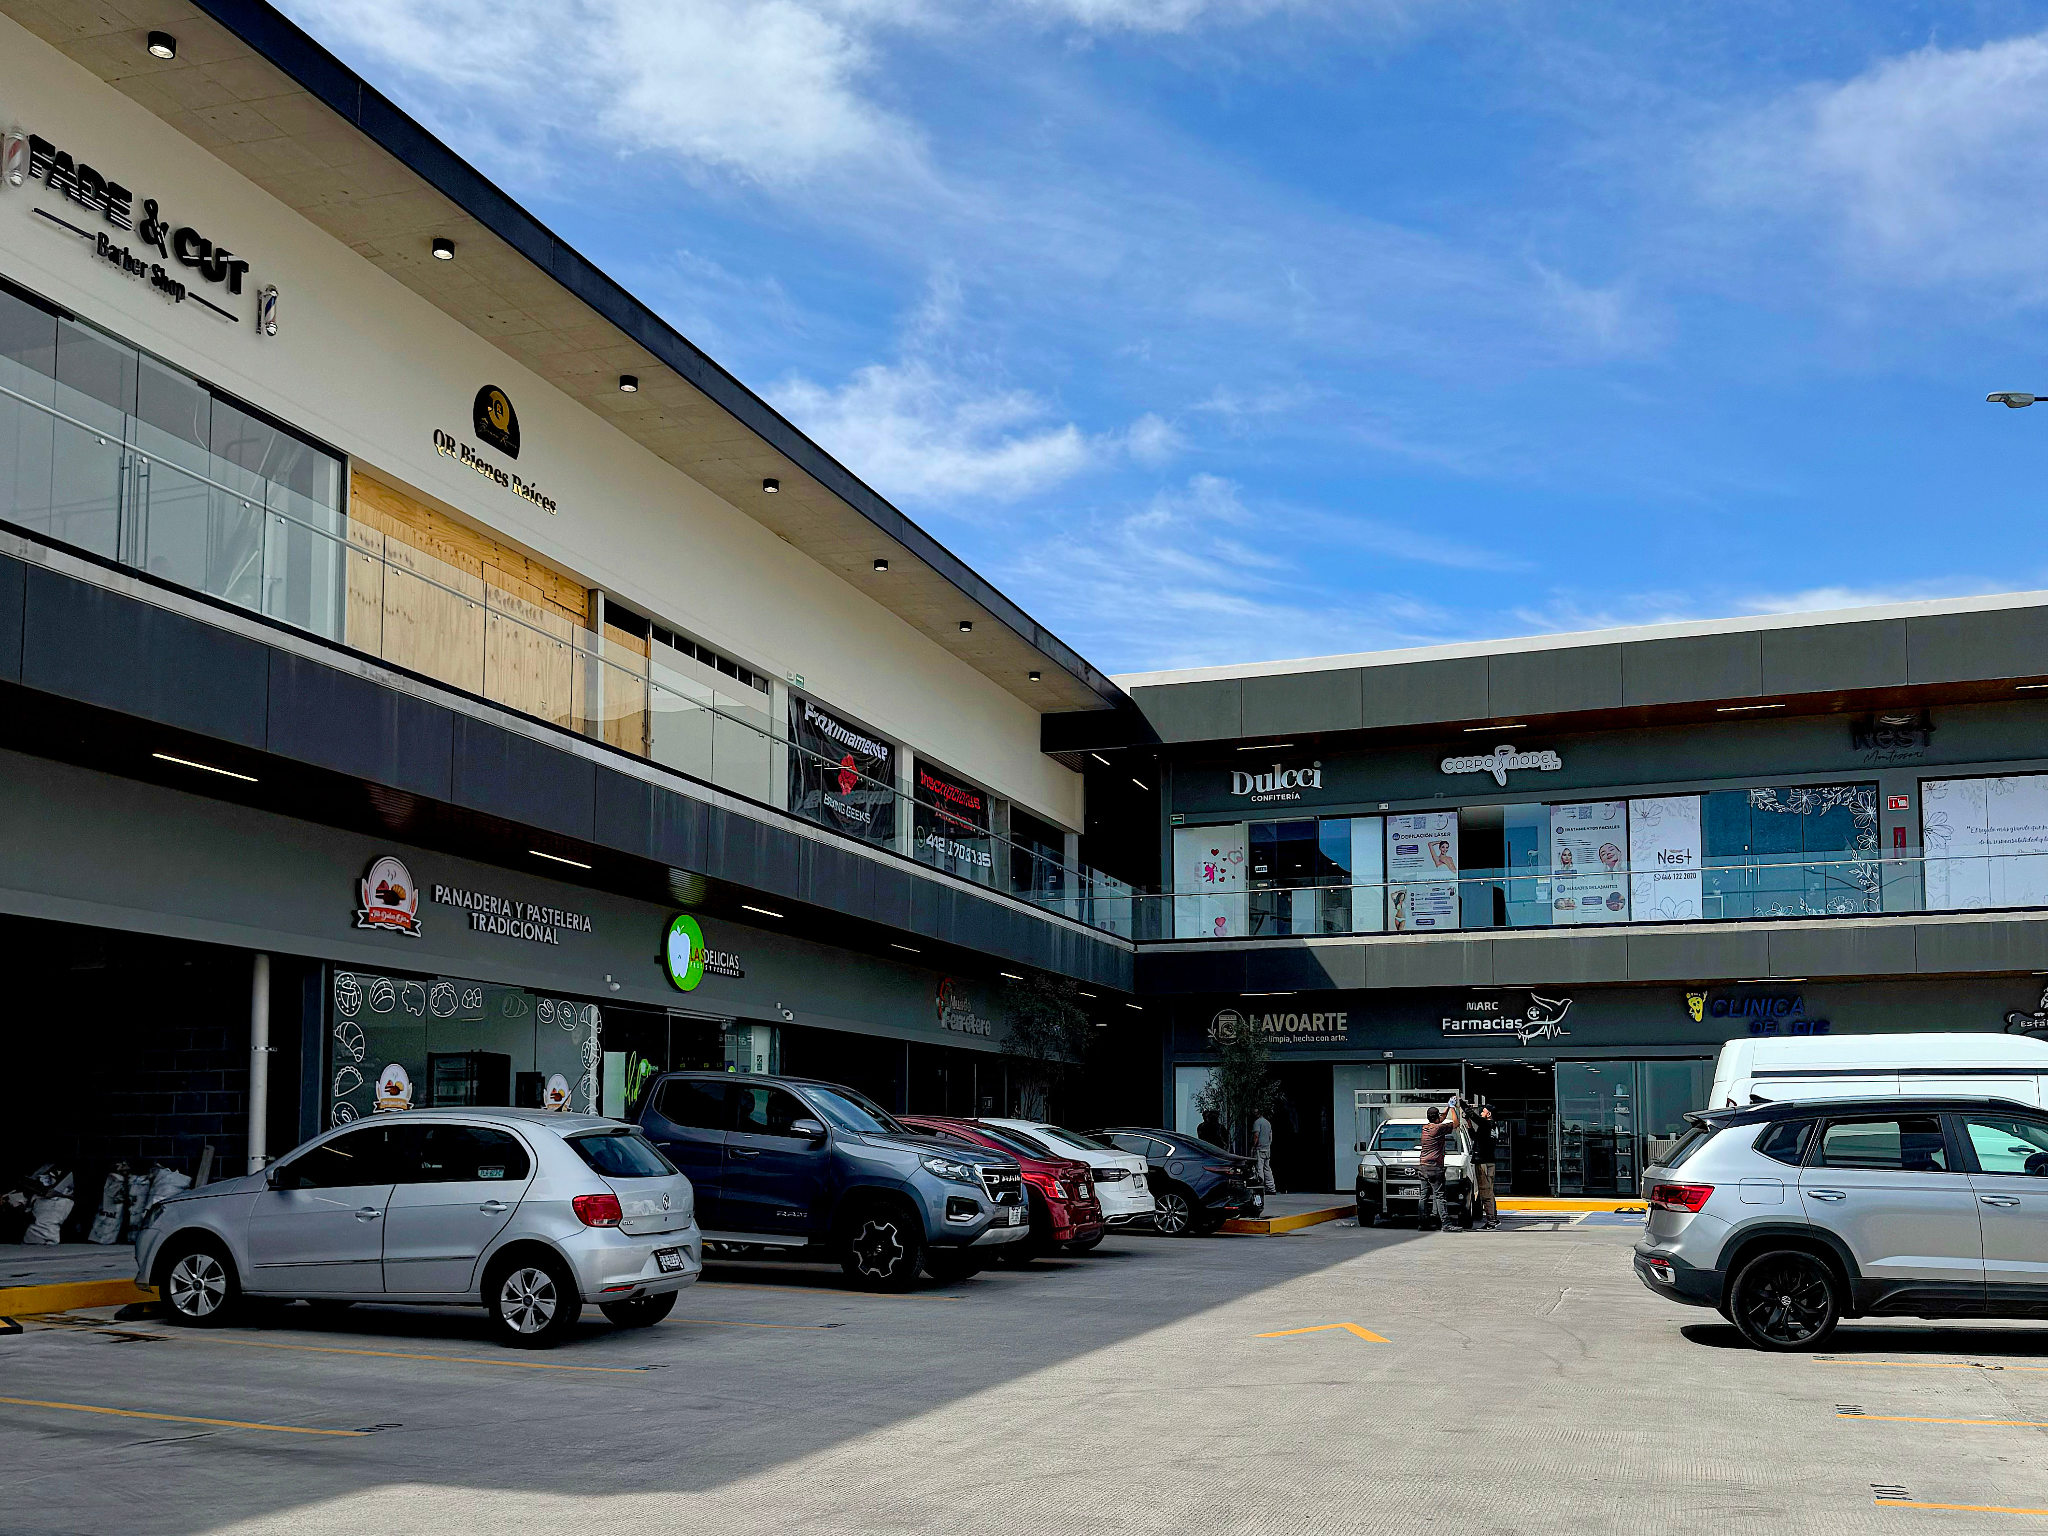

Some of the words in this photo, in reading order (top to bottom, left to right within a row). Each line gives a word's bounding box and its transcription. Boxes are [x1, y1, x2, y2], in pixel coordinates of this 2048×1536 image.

[29, 134, 133, 231] FADE
[173, 226, 249, 295] CUT
[97, 231, 148, 278] Barber
[151, 263, 186, 303] Shop
[433, 428, 457, 459] QR
[459, 443, 509, 488] Bienes
[511, 473, 557, 515] Raíces
[1444, 758, 1494, 771] CORPO
[1508, 754, 1558, 768] MODEL
[1230, 760, 1322, 795] Dulcci
[1251, 791, 1301, 802] CONFITERÍA
[846, 805, 871, 824] GEEKS
[1657, 848, 1693, 865] Nest
[435, 884, 511, 917] PANADERIA
[515, 901, 525, 919] Y
[526, 904, 592, 933] PASTELERIA
[472, 912, 559, 945] TRADICIONAL
[703, 948, 740, 970] DELICIAS
[1466, 1001, 1499, 1011] MARC
[1442, 1016, 1523, 1030] Farmacias
[1293, 1034, 1315, 1042] hecha
